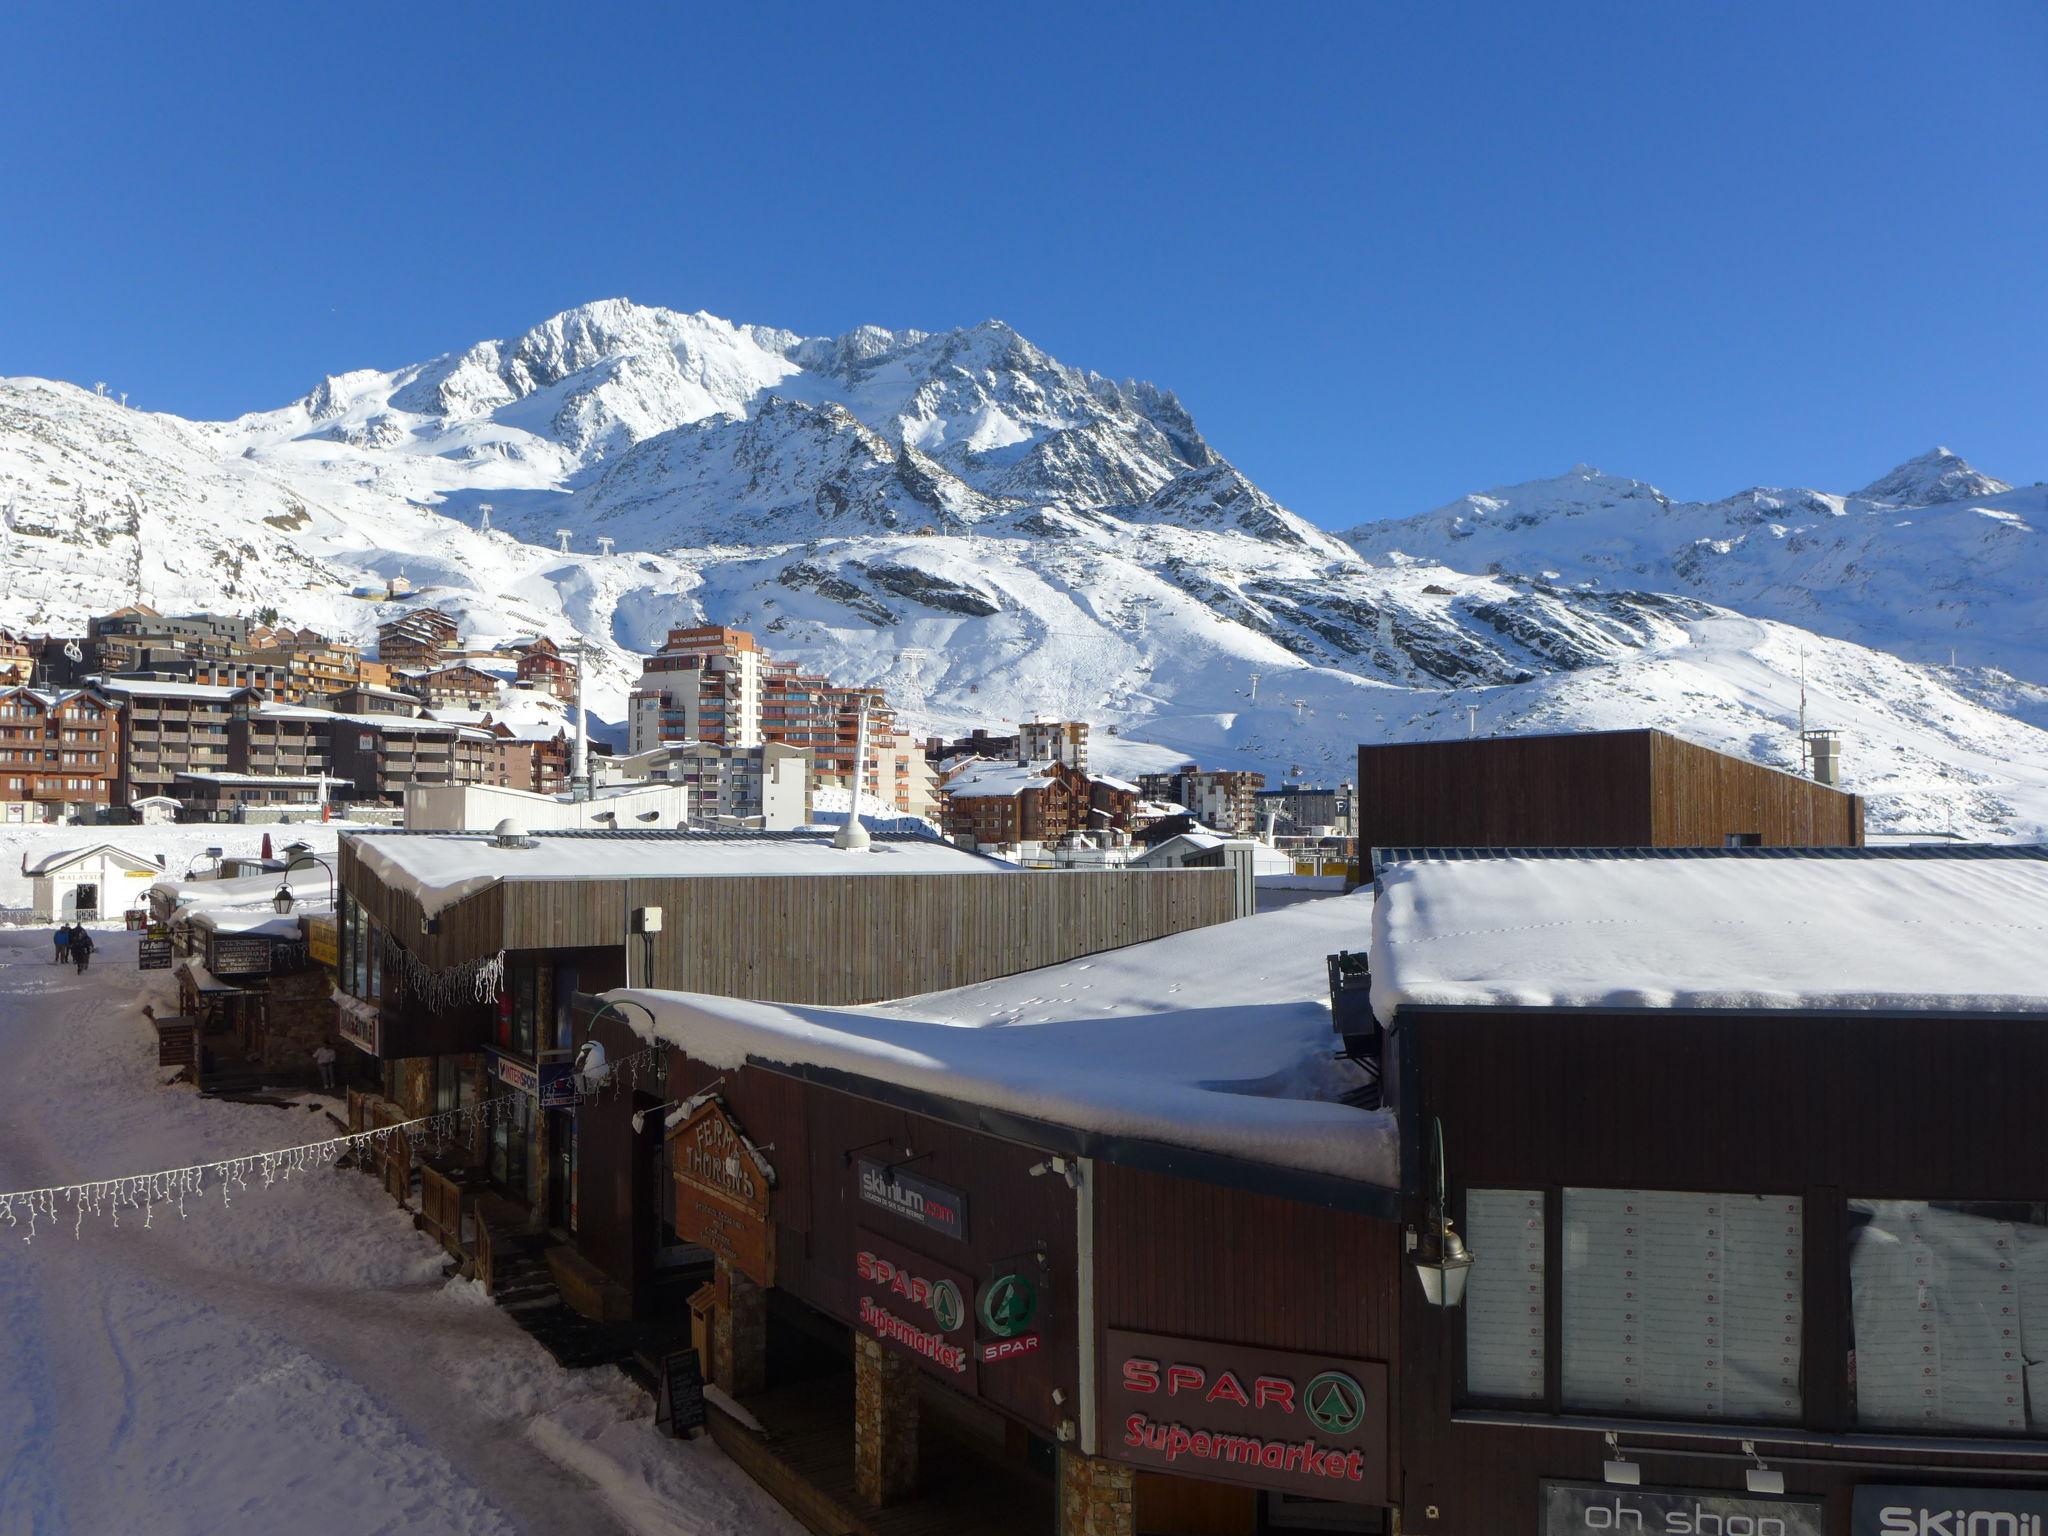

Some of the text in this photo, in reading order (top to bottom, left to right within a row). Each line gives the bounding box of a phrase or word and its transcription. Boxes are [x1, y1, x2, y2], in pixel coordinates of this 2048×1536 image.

[696, 1118, 739, 1157] FERM
[857, 1251, 932, 1309] SPAR
[860, 1296, 966, 1373] Supermarket
[985, 1337, 1038, 1359] SPAR
[1122, 1358, 1296, 1414] SPAR
[1124, 1412, 1365, 1481] Supermarket
[1584, 1498, 1642, 1531] oh
